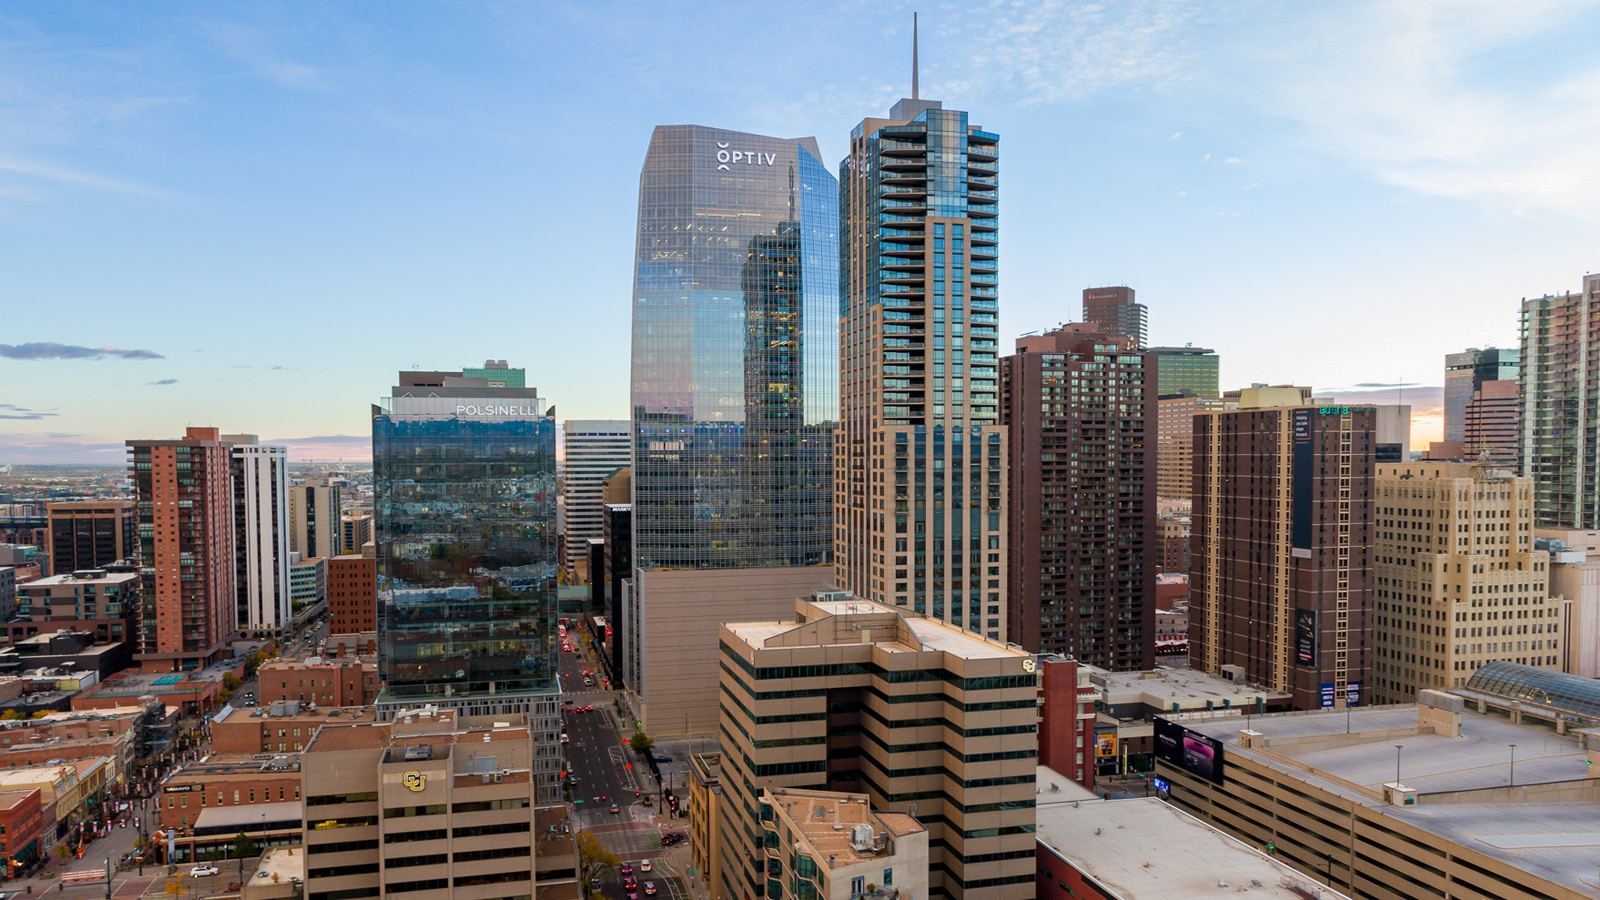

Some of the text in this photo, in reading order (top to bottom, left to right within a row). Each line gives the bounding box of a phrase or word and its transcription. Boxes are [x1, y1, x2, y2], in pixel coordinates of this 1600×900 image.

[717, 149, 776, 166] OPTIV
[456, 405, 538, 416] POLSINELLI
[403, 770, 427, 792] CU
